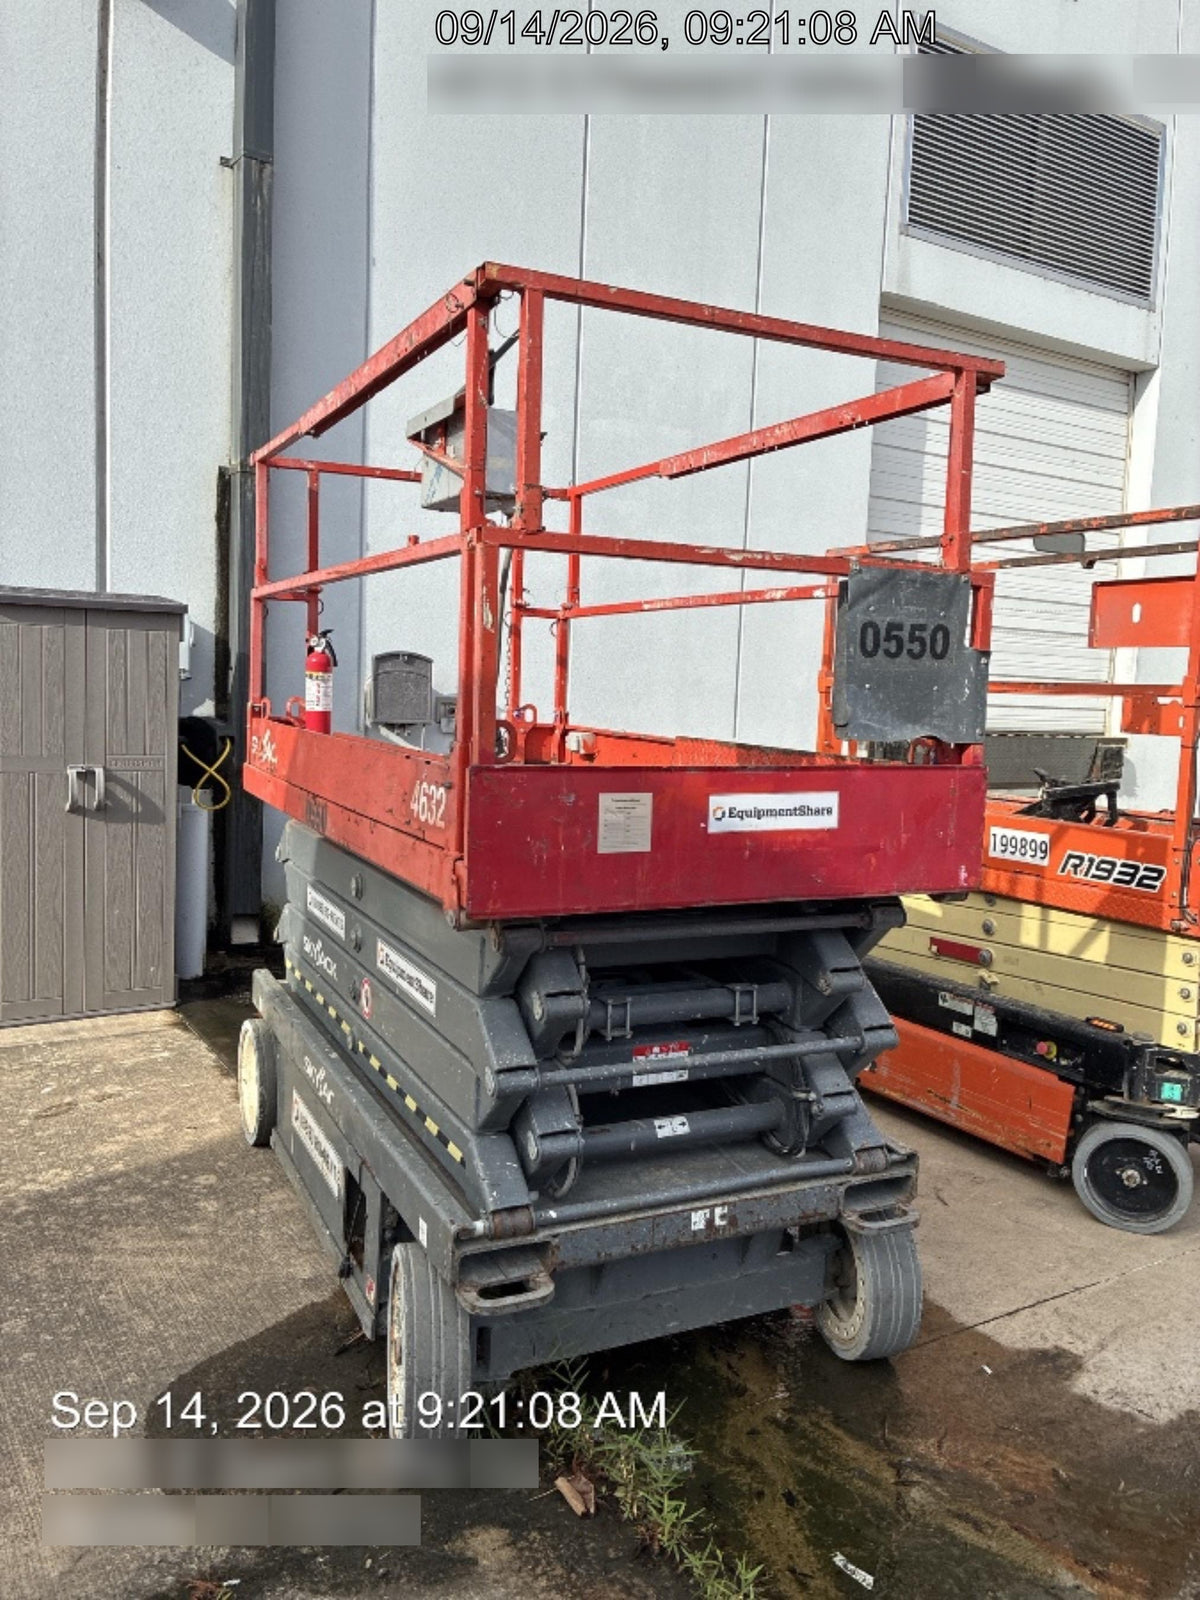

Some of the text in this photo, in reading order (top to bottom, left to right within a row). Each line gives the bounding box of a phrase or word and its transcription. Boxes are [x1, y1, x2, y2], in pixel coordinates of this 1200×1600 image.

[860, 621, 950, 660] 0550
[410, 780, 446, 829] 4632
[728, 804, 833, 820] EquipmentShare
[991, 833, 1048, 860] 199899
[1058, 851, 1166, 892] R1932
